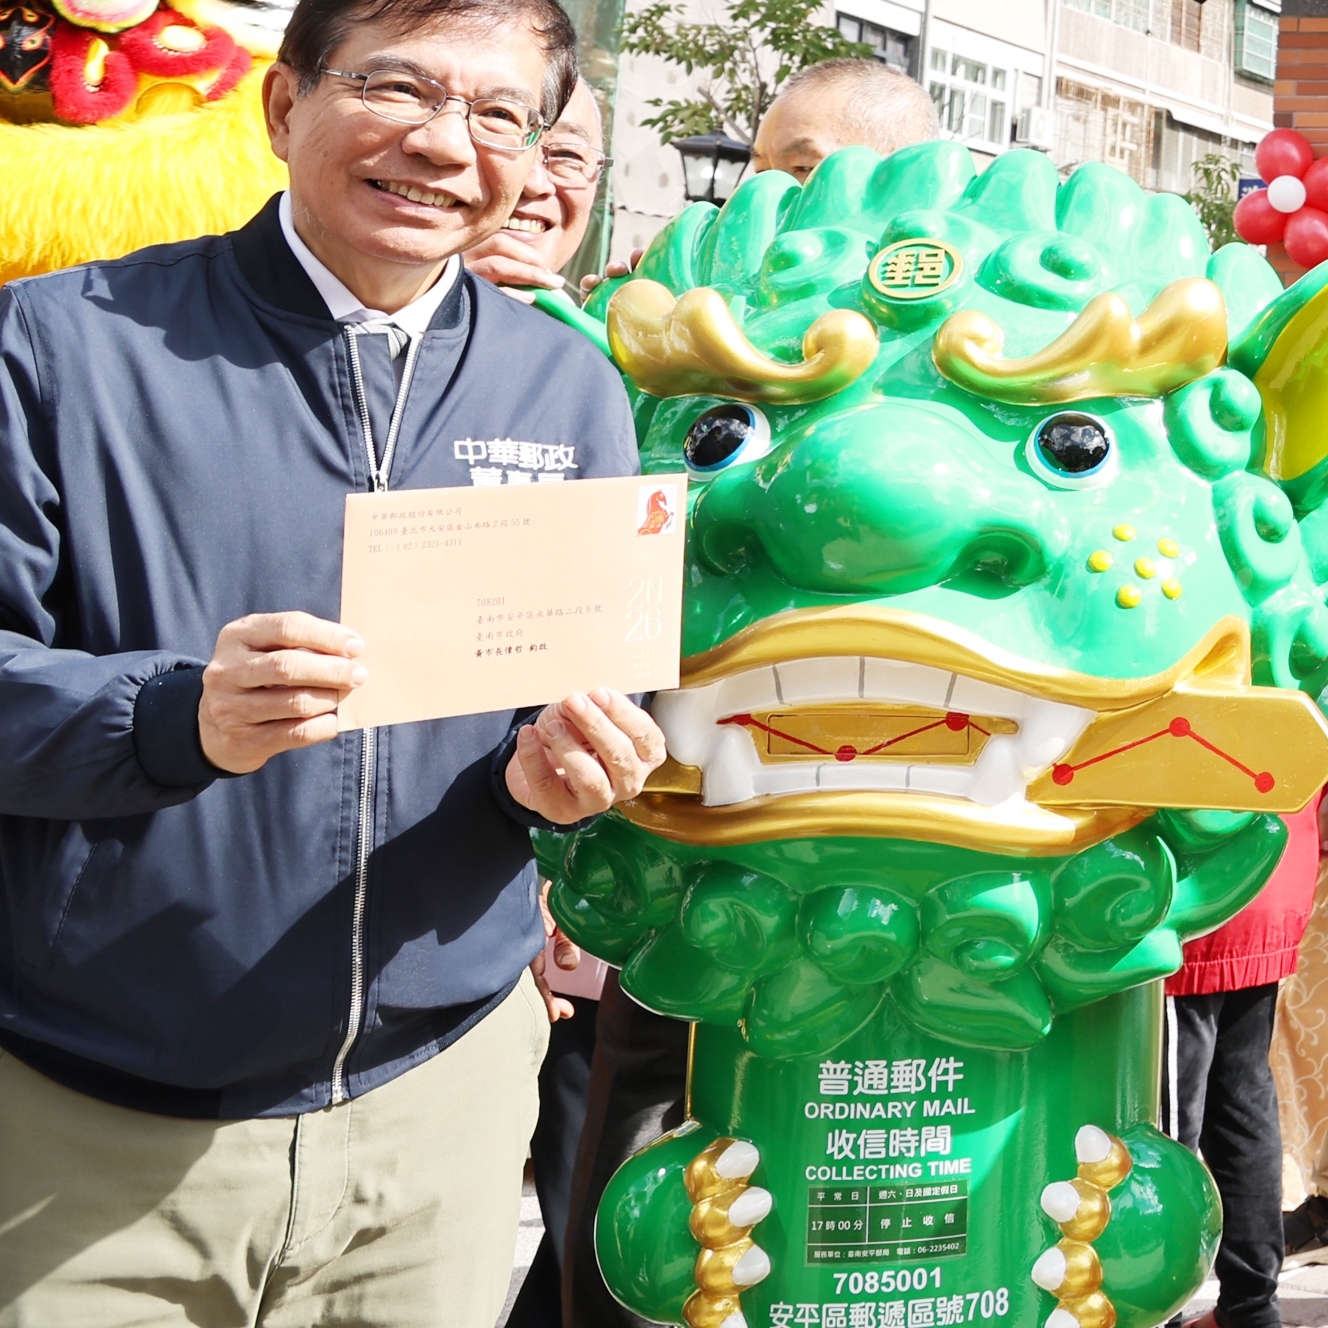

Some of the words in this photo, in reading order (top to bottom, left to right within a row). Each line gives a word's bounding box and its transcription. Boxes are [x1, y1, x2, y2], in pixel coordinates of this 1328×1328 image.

[453, 437, 579, 471] 中華郵政
[371, 507, 462, 521] 中華郵政股份有限公司
[476, 596, 506, 607] 708201
[475, 628, 524, 642] 臺南市政府
[817, 1056, 964, 1096] 普通郵件
[804, 1101, 917, 1120] ORDINARY
[923, 1097, 976, 1117] MAIL
[825, 1124, 952, 1161] 收信時間
[805, 1162, 923, 1181] COLLECTING
[927, 1157, 972, 1176] TIME
[833, 1266, 942, 1295] 7085001
[768, 1286, 1010, 1328] 安平區郵遞區號708
